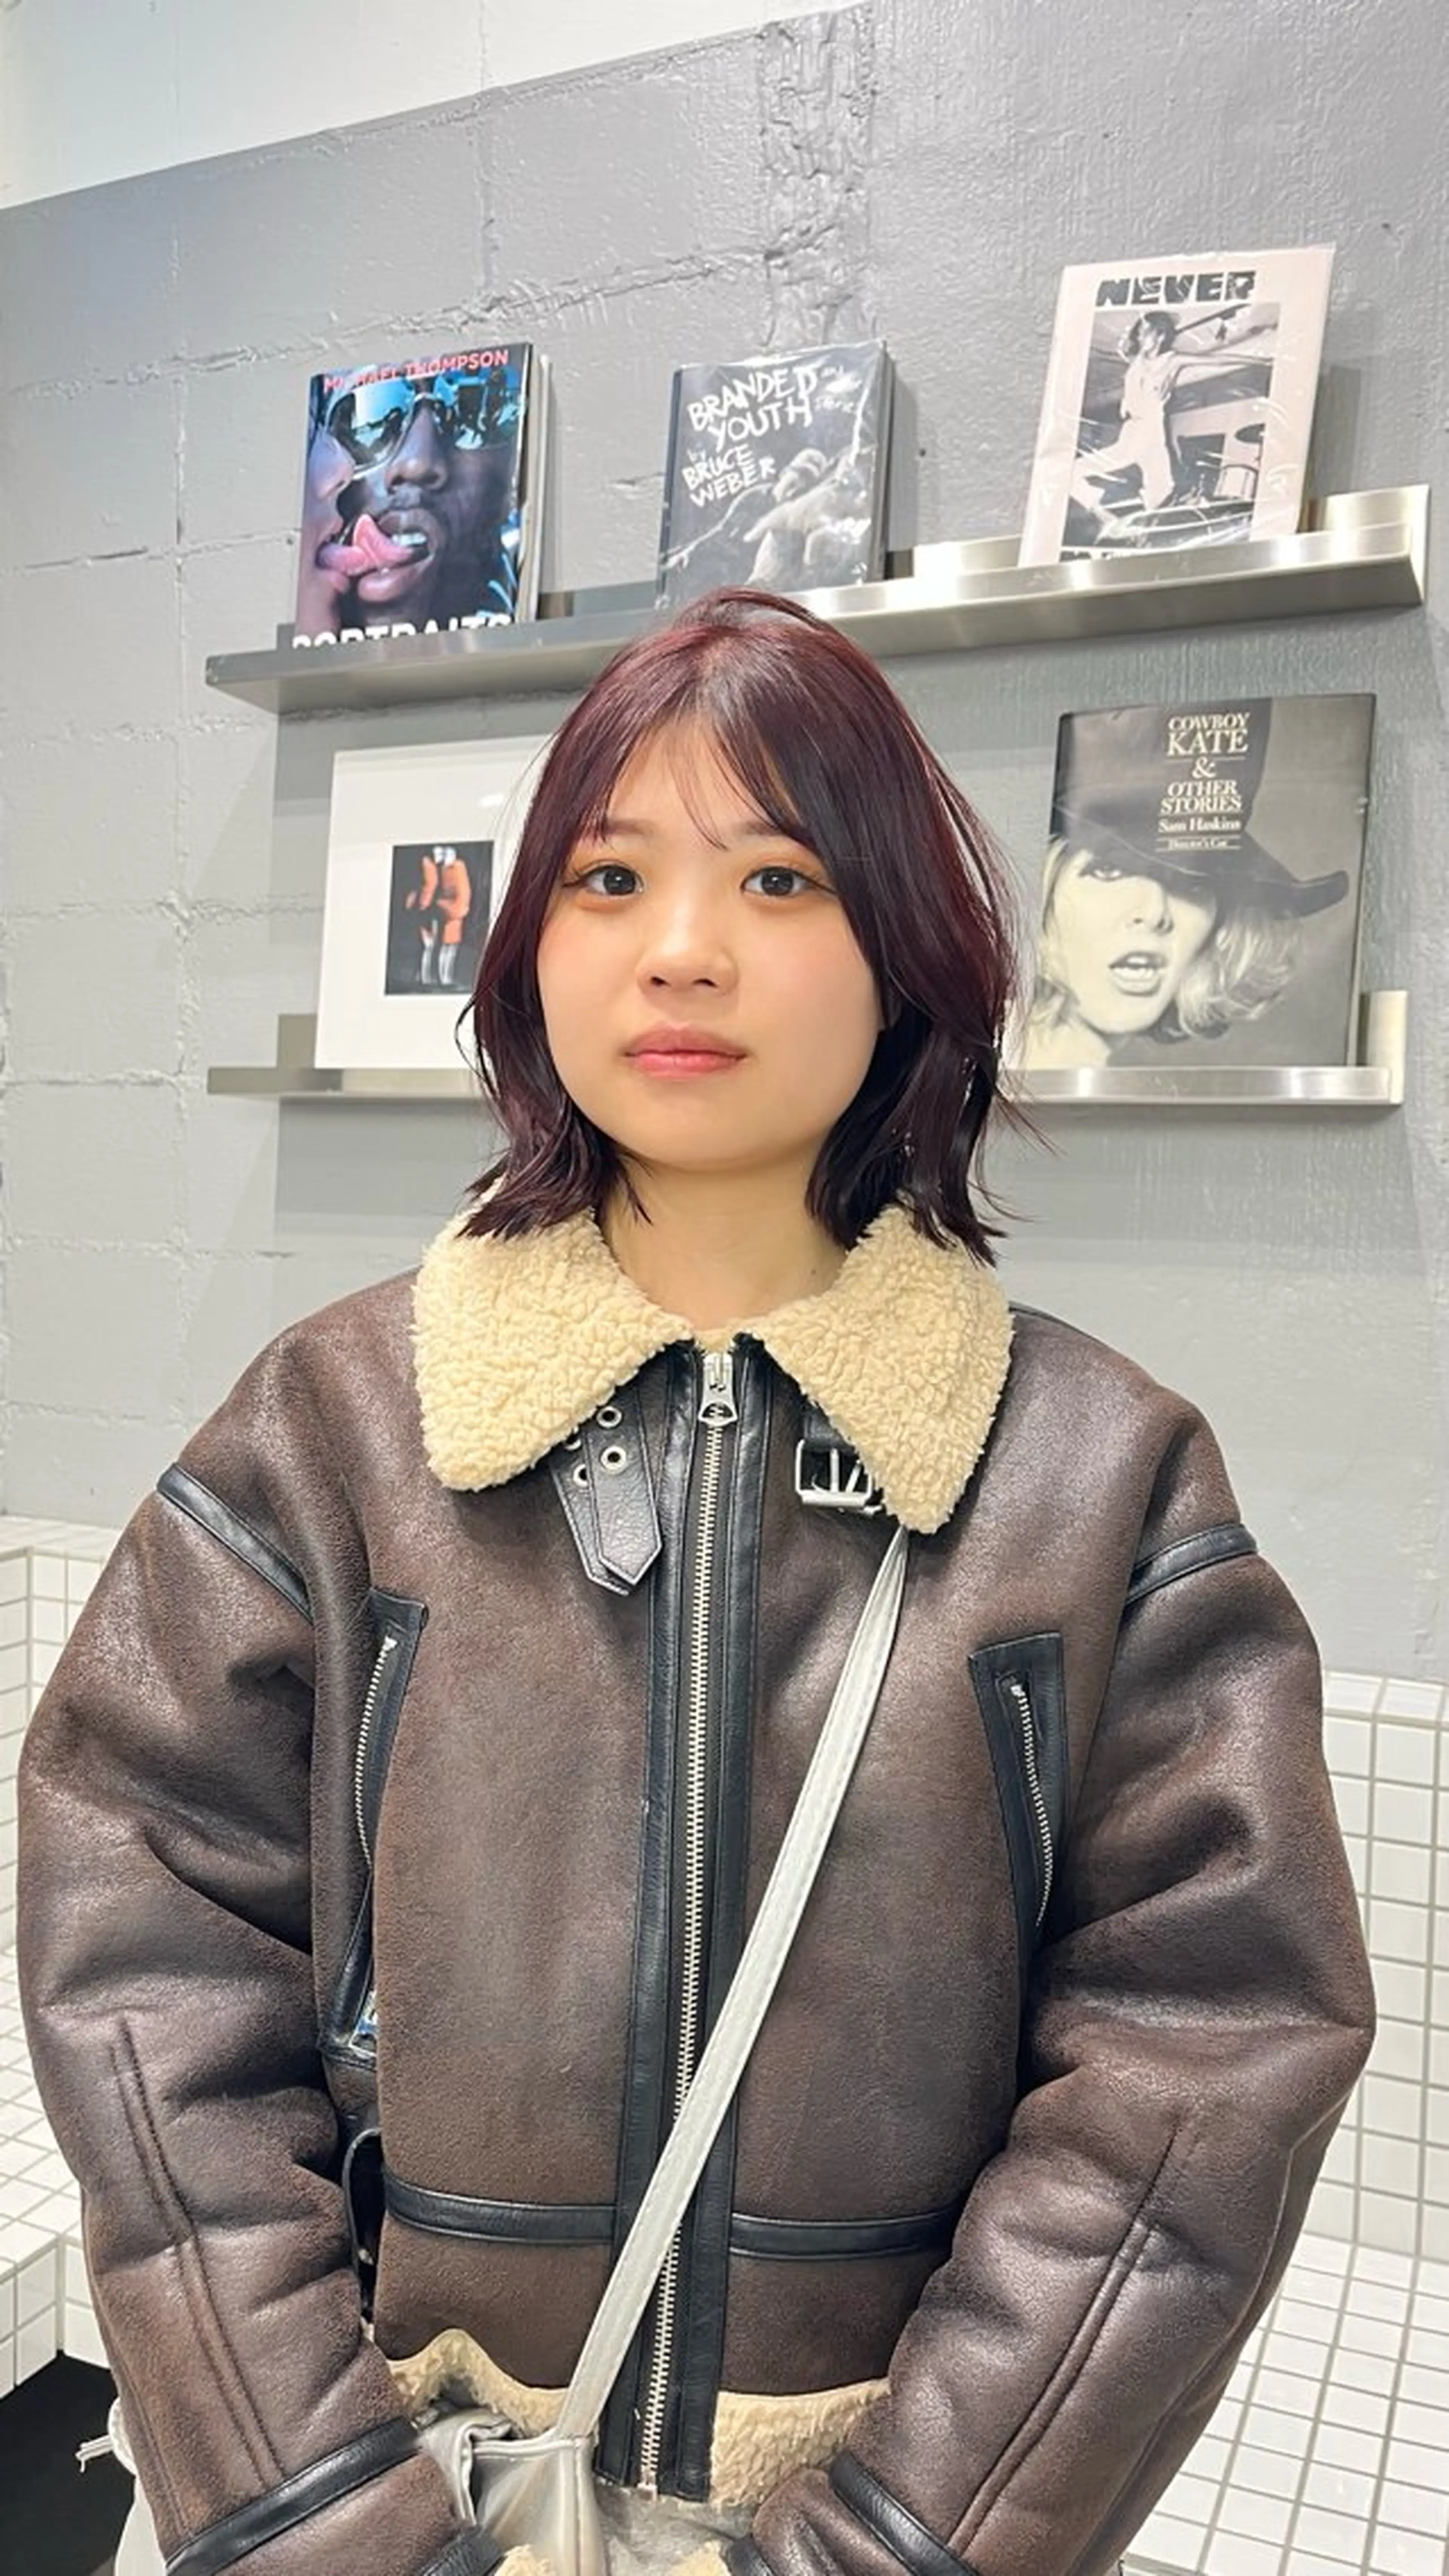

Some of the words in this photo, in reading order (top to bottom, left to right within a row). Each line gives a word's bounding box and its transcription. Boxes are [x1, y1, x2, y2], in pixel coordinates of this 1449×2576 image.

[1095, 271, 1256, 306] NEVER
[406, 349, 508, 377] THOMPSON
[686, 363, 821, 431] BRANDED
[707, 395, 813, 453] YOUTH
[682, 443, 755, 491] BRUCE
[689, 455, 776, 508] WEBER
[1167, 711, 1251, 731] COWBOY
[1166, 728, 1249, 756] KATE
[1191, 756, 1217, 778] &
[1167, 779, 1238, 797] OTHER
[1160, 795, 1243, 814] STORIES
[1158, 818, 1187, 833] Sam
[1189, 816, 1241, 832] Haskins
